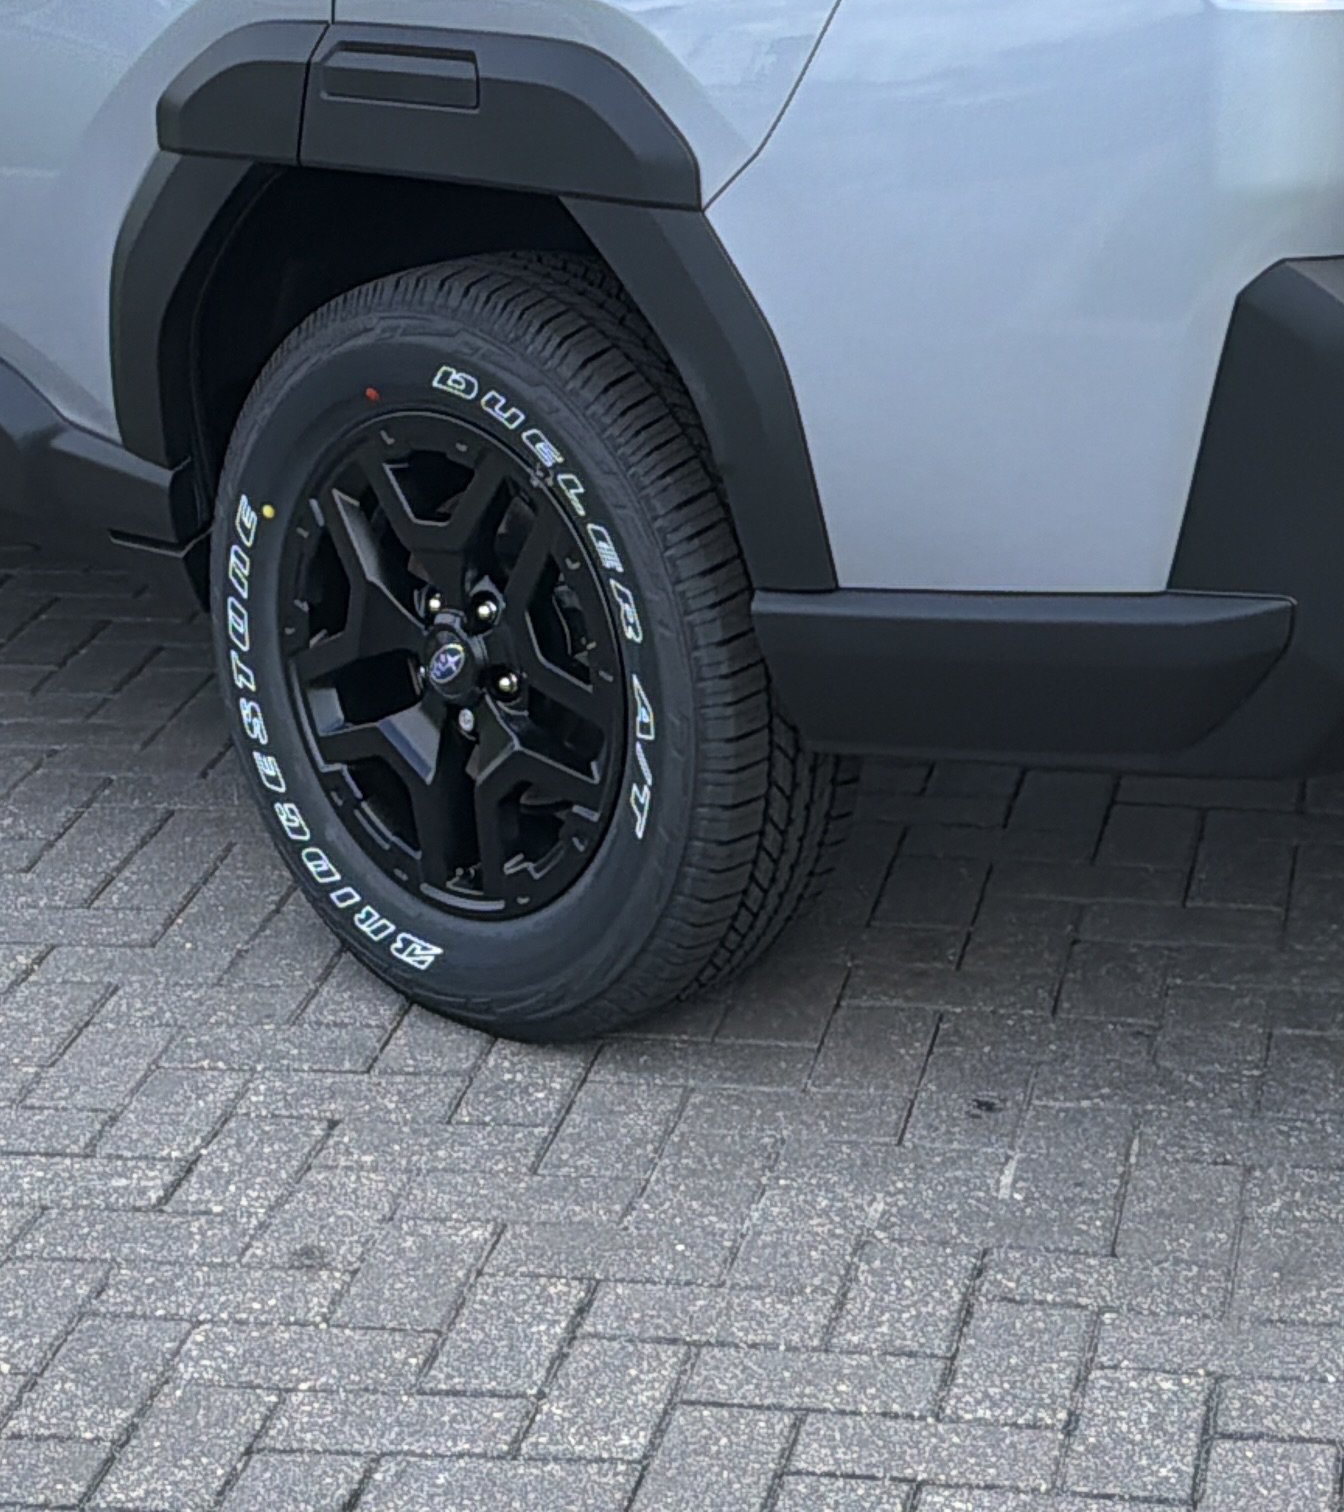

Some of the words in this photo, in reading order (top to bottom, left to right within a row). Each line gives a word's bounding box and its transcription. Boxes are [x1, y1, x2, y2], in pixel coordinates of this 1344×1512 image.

[227, 493, 444, 971] BRIDGESTONE
[431, 365, 643, 645] DUELER
[629, 673, 655, 840] A/T
